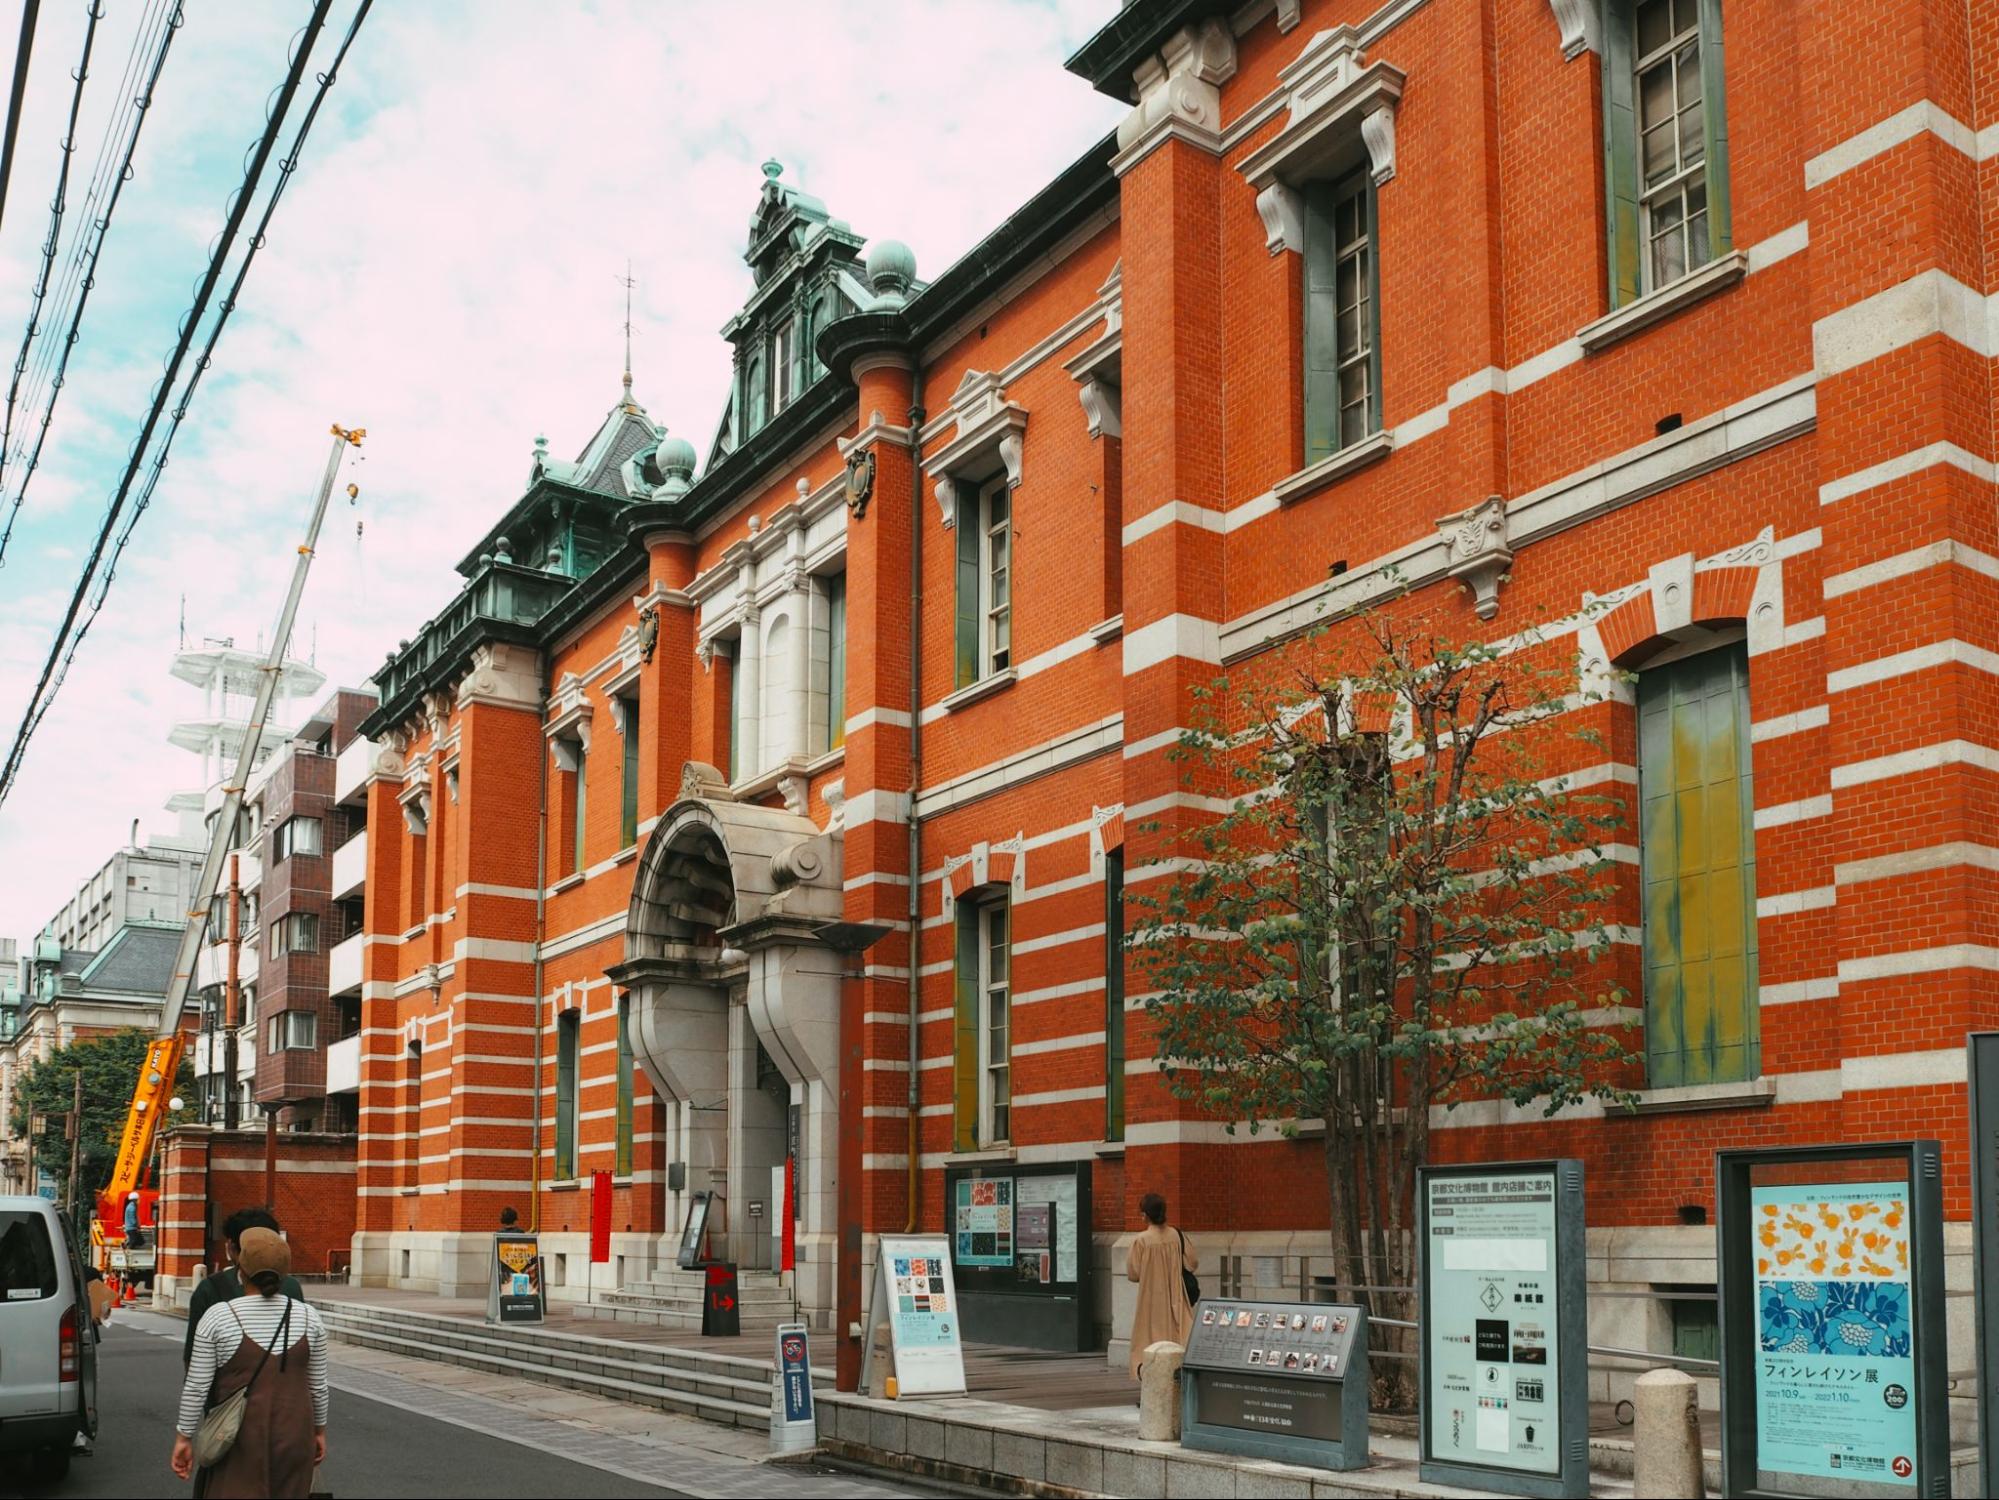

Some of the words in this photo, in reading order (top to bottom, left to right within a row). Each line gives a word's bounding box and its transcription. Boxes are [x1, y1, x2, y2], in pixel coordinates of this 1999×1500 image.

[151, 1049, 161, 1069] KATO
[1764, 1364, 1879, 1383] フィンレイソン展
